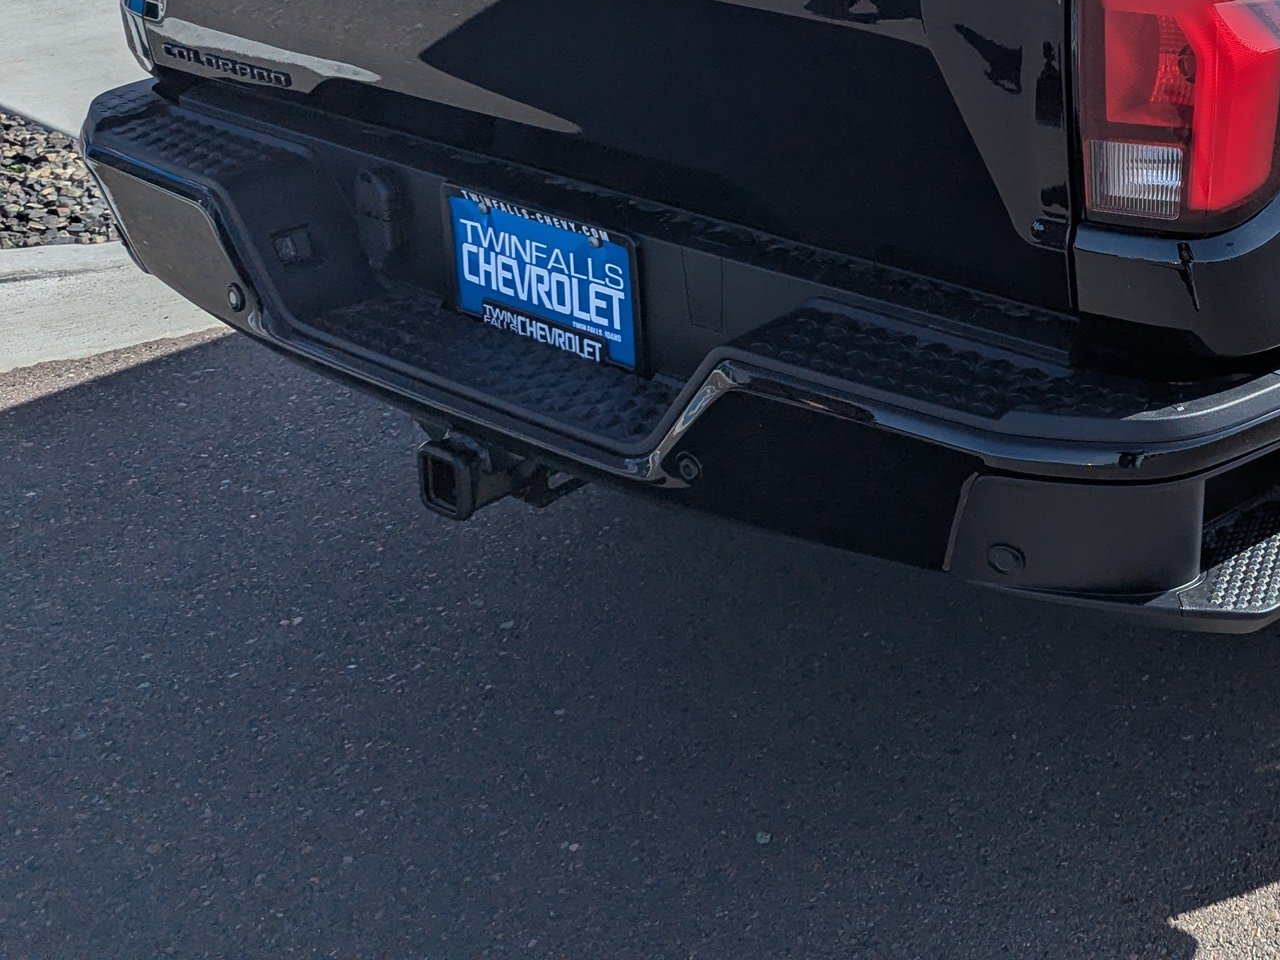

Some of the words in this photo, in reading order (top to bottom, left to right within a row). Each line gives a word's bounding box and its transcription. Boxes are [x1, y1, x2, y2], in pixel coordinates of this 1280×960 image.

[162, 42, 293, 88] COLORADO
[461, 190, 610, 243] TWINFALLS-CHEVY.COM
[462, 243, 625, 330] CHEVROLET
[483, 304, 517, 325] TWIN
[518, 316, 602, 362] CHEVROLET
